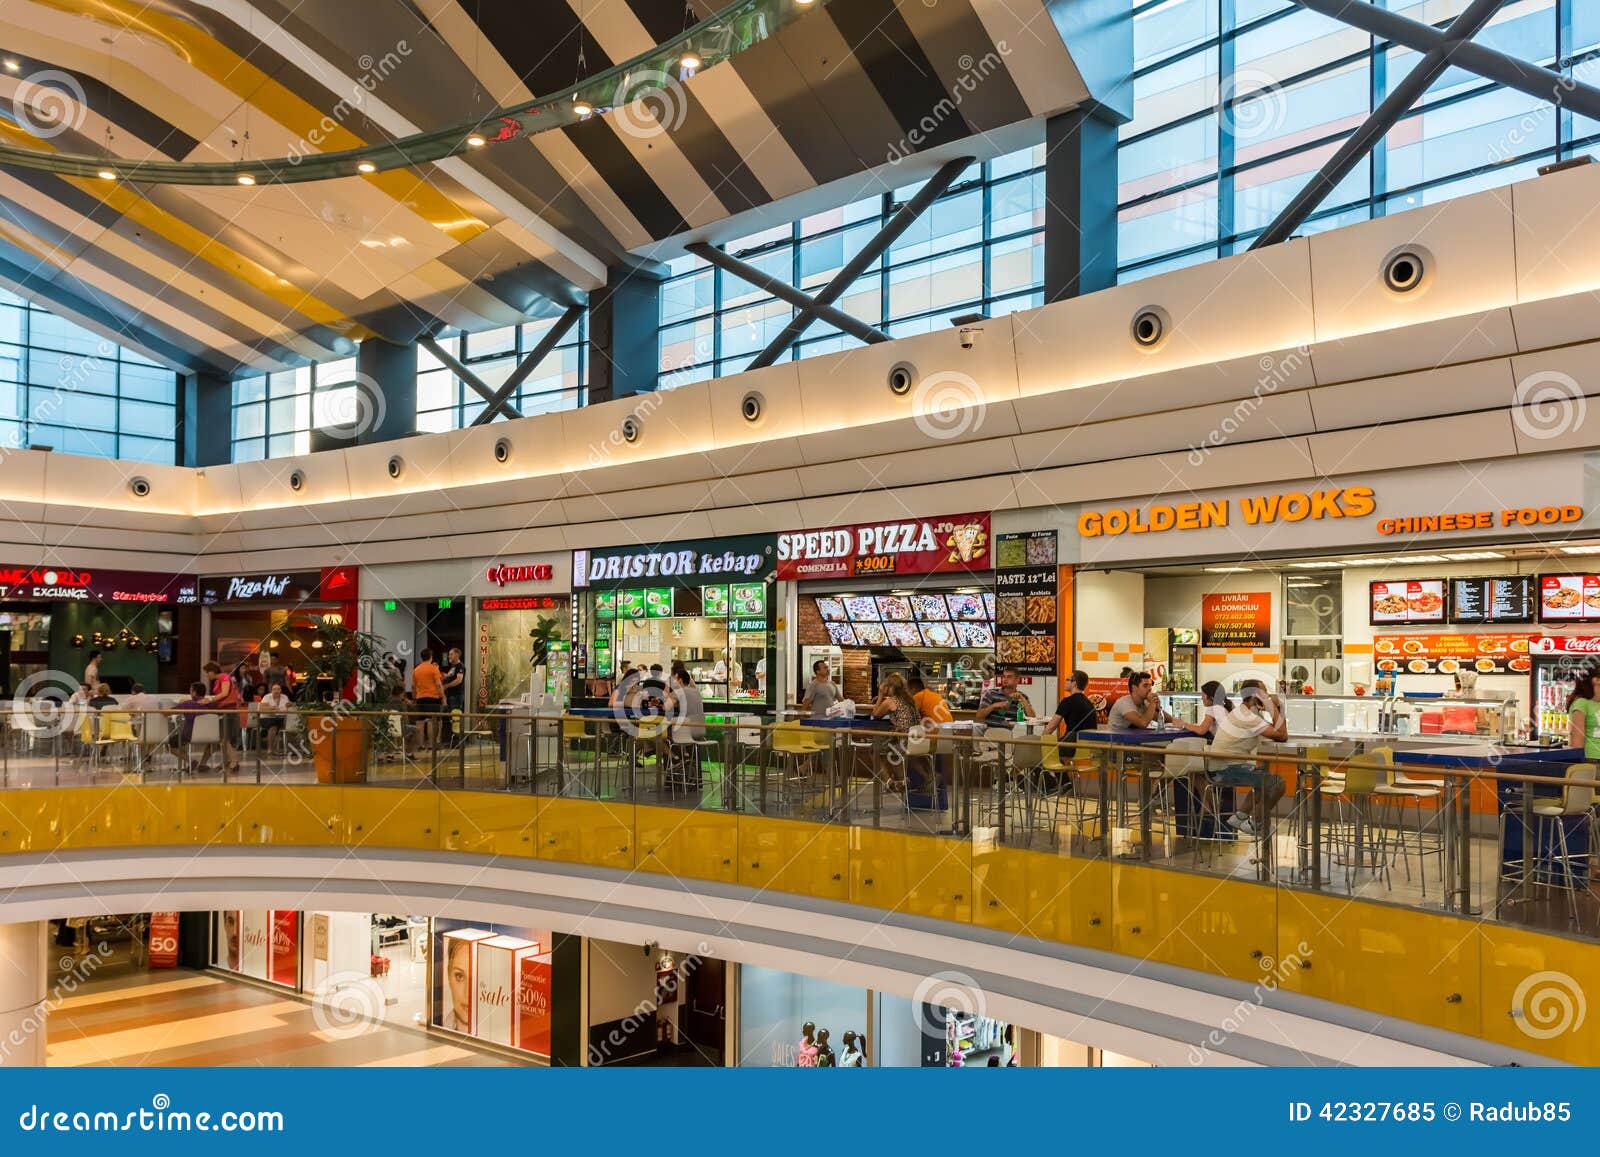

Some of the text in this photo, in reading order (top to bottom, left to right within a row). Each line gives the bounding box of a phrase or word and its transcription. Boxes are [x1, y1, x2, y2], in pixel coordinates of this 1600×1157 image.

[1077, 485, 1585, 538] GOLDEN WOKS CHINESE FOOD
[777, 530, 853, 561] SPEED
[857, 522, 939, 556] PIZZA
[588, 550, 696, 581] DRISTOR
[698, 551, 763, 575] kebap
[797, 563, 835, 574] COMENZI
[836, 562, 848, 572] LA
[226, 576, 262, 599] Pizza
[260, 575, 291, 596] Hut
[997, 573, 1026, 585] PASTE
[1042, 572, 1056, 583] Lei
[32, 586, 89, 600] EXCHANGE
[1221, 603, 1260, 612] DOMICILIU
[480, 985, 511, 1007] sale
[518, 985, 547, 1010] 50%
